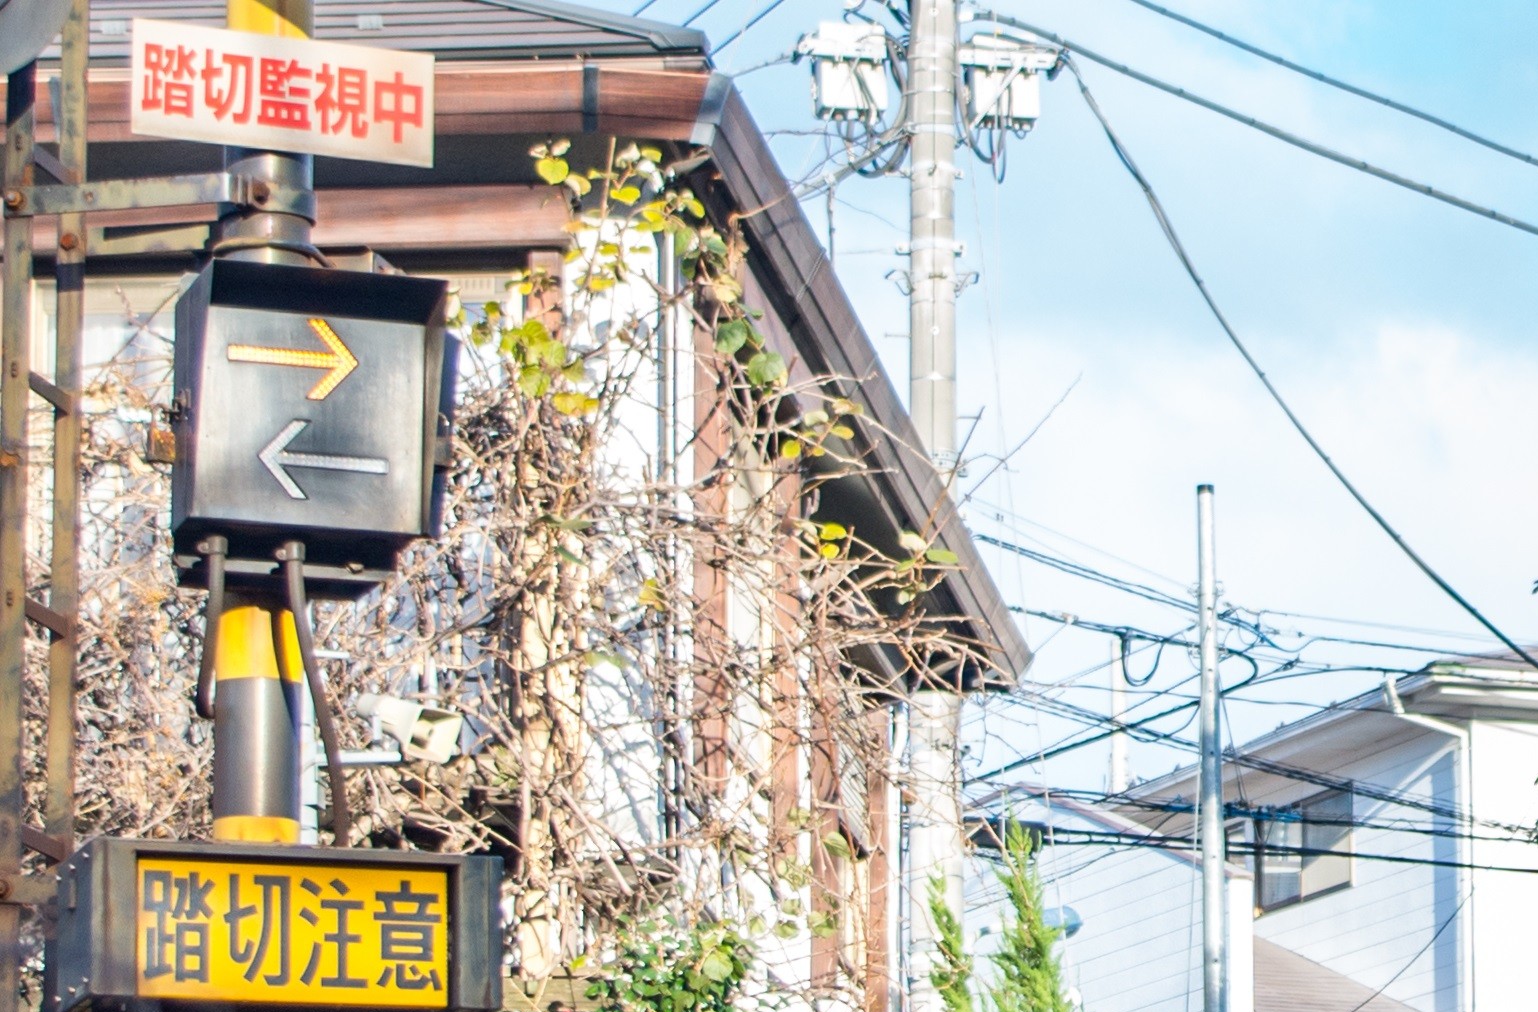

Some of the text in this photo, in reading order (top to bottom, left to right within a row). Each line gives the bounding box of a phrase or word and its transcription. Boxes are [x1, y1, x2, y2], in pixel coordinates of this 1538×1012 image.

[140, 43, 425, 144] 踏切監視中
[142, 870, 443, 992] 踏切注意
